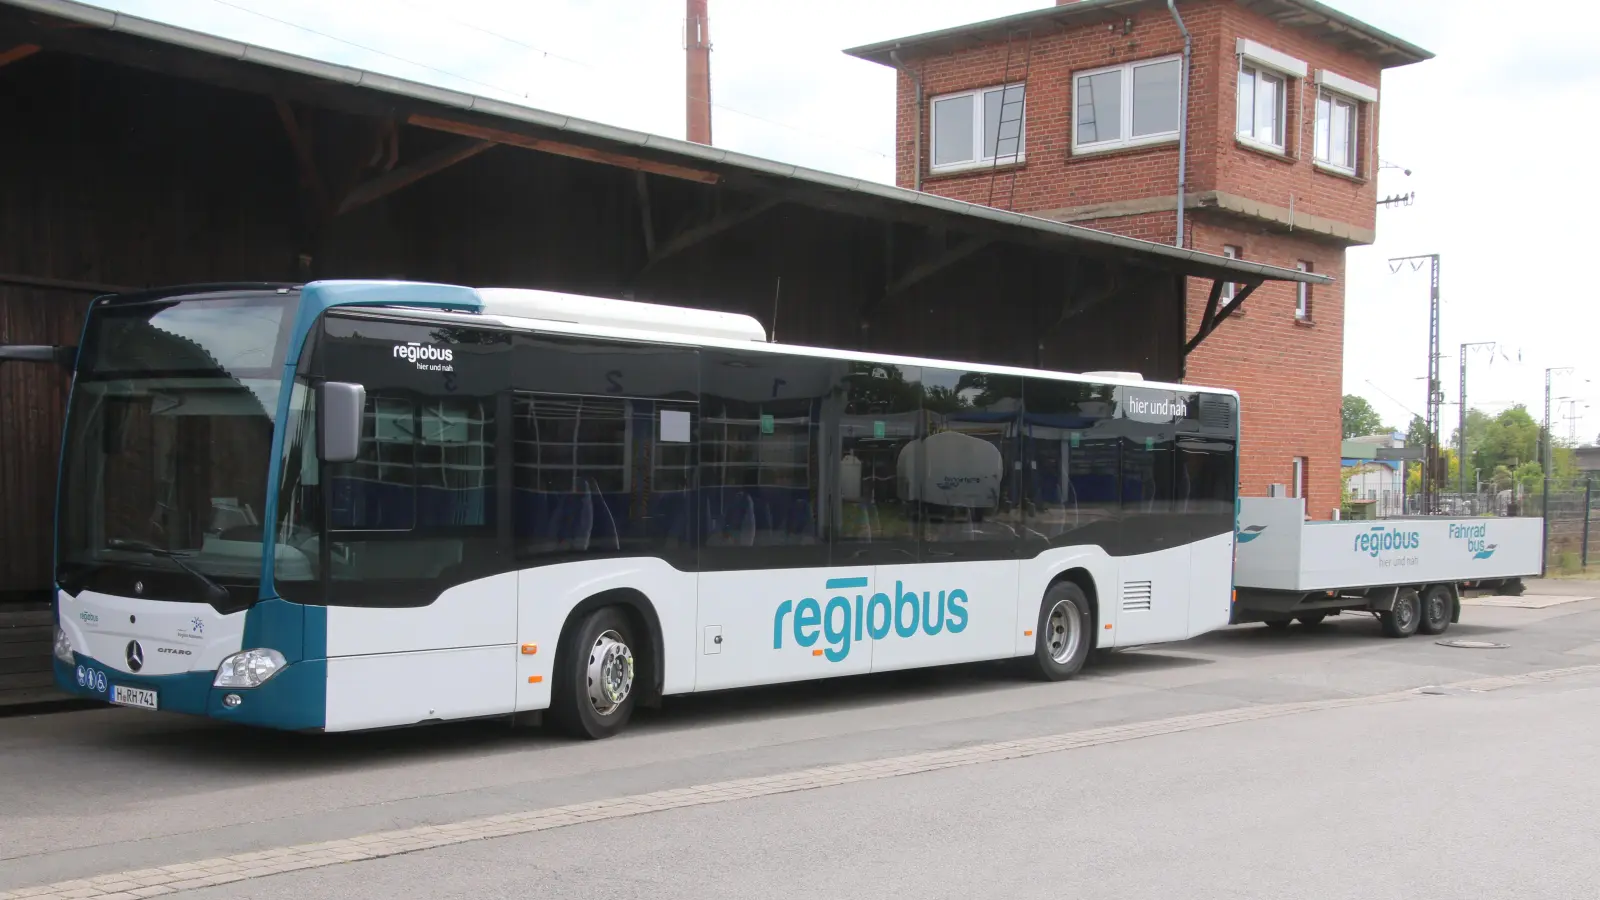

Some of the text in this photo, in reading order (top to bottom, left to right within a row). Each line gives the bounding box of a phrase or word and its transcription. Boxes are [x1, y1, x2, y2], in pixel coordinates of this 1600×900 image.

[393, 342, 453, 363] regiobus
[416, 362, 429, 370] hier
[1129, 396, 1187, 417] hier und nah
[1449, 522, 1486, 539] Fahrrad
[1354, 526, 1419, 558] regiobus
[1467, 538, 1485, 552] bus
[1379, 558, 1391, 567] hier
[1393, 556, 1406, 567] und
[773, 577, 969, 662] regiobus
[157, 647, 192, 656] CITARO
[116, 687, 122, 701] H
[127, 689, 138, 703] RH
[139, 691, 154, 706] 741
